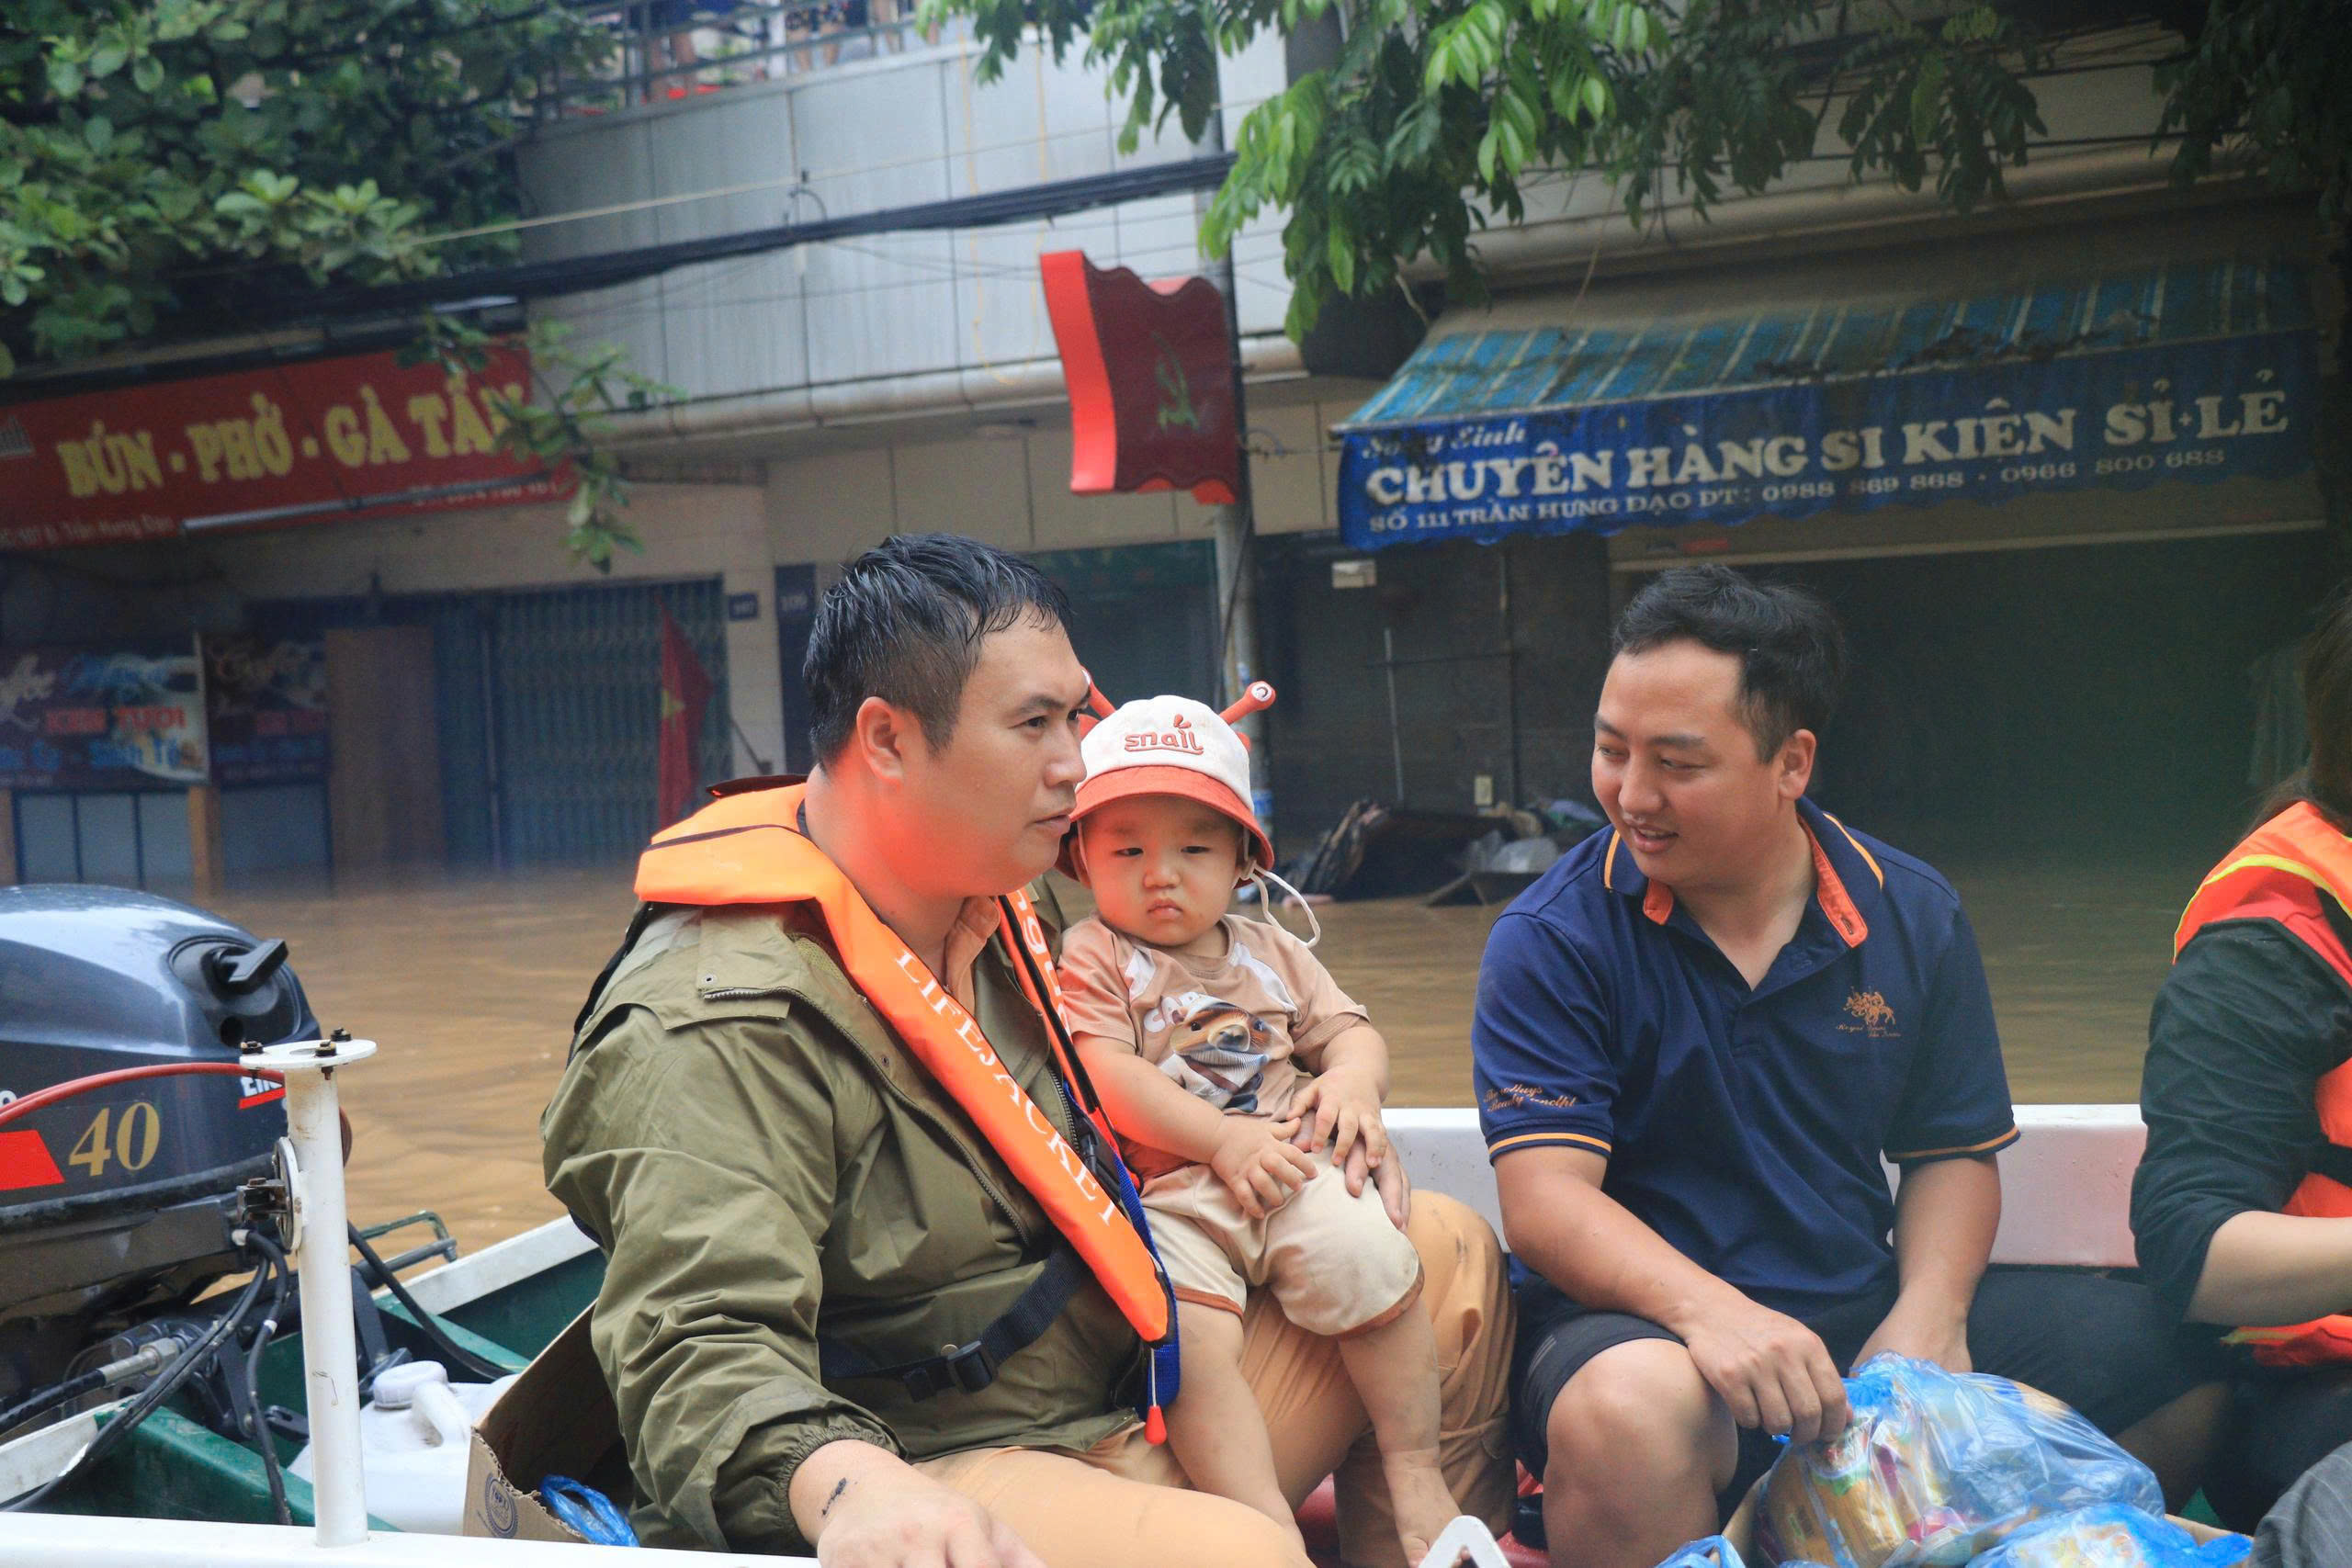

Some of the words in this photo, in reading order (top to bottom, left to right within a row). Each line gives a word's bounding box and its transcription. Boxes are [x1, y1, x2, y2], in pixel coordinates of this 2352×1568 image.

[324, 380, 413, 468] GÀ
[1365, 440, 1615, 505] CHUYÊN
[1625, 423, 1810, 489] HÀNG
[1125, 727, 1204, 755] snail
[68, 1102, 160, 1176] 40
